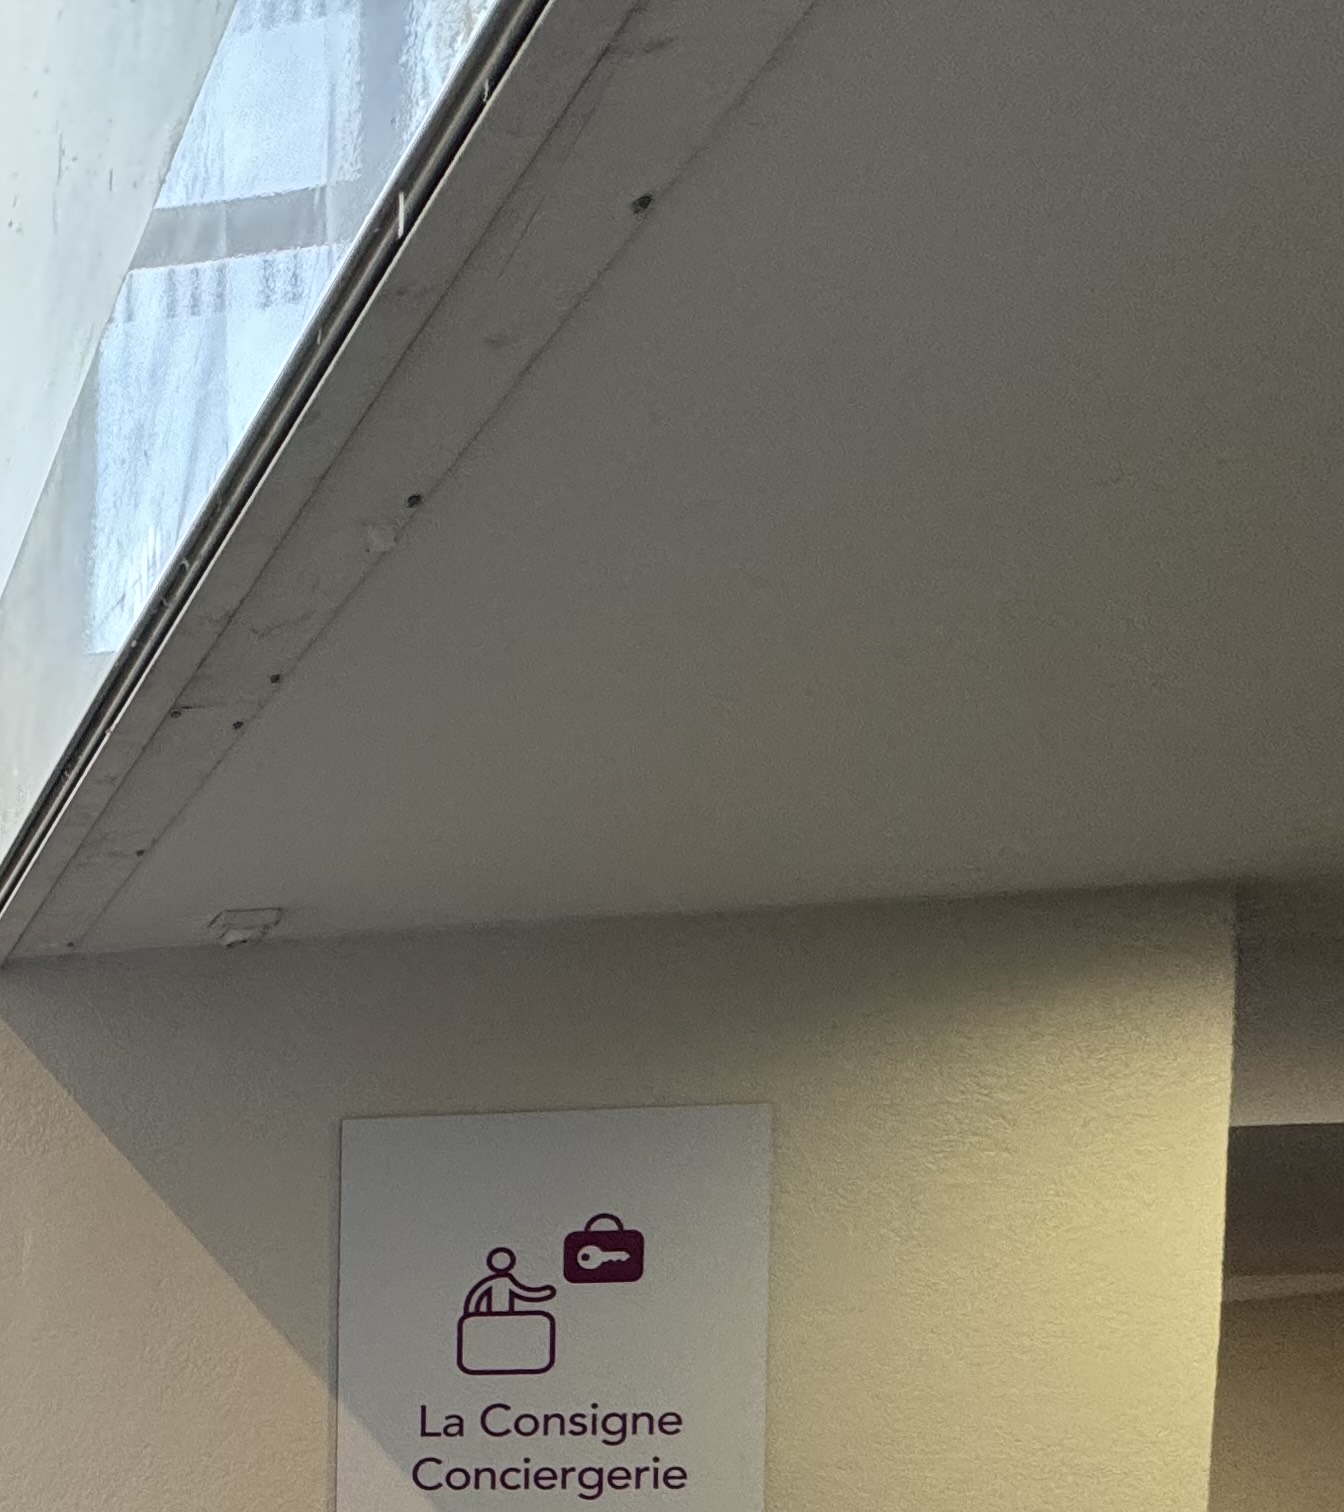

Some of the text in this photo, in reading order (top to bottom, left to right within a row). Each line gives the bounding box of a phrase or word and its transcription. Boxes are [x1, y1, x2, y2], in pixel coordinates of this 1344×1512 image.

[420, 1402, 683, 1446] La Consigne
[412, 1456, 687, 1500] Conciergerie
